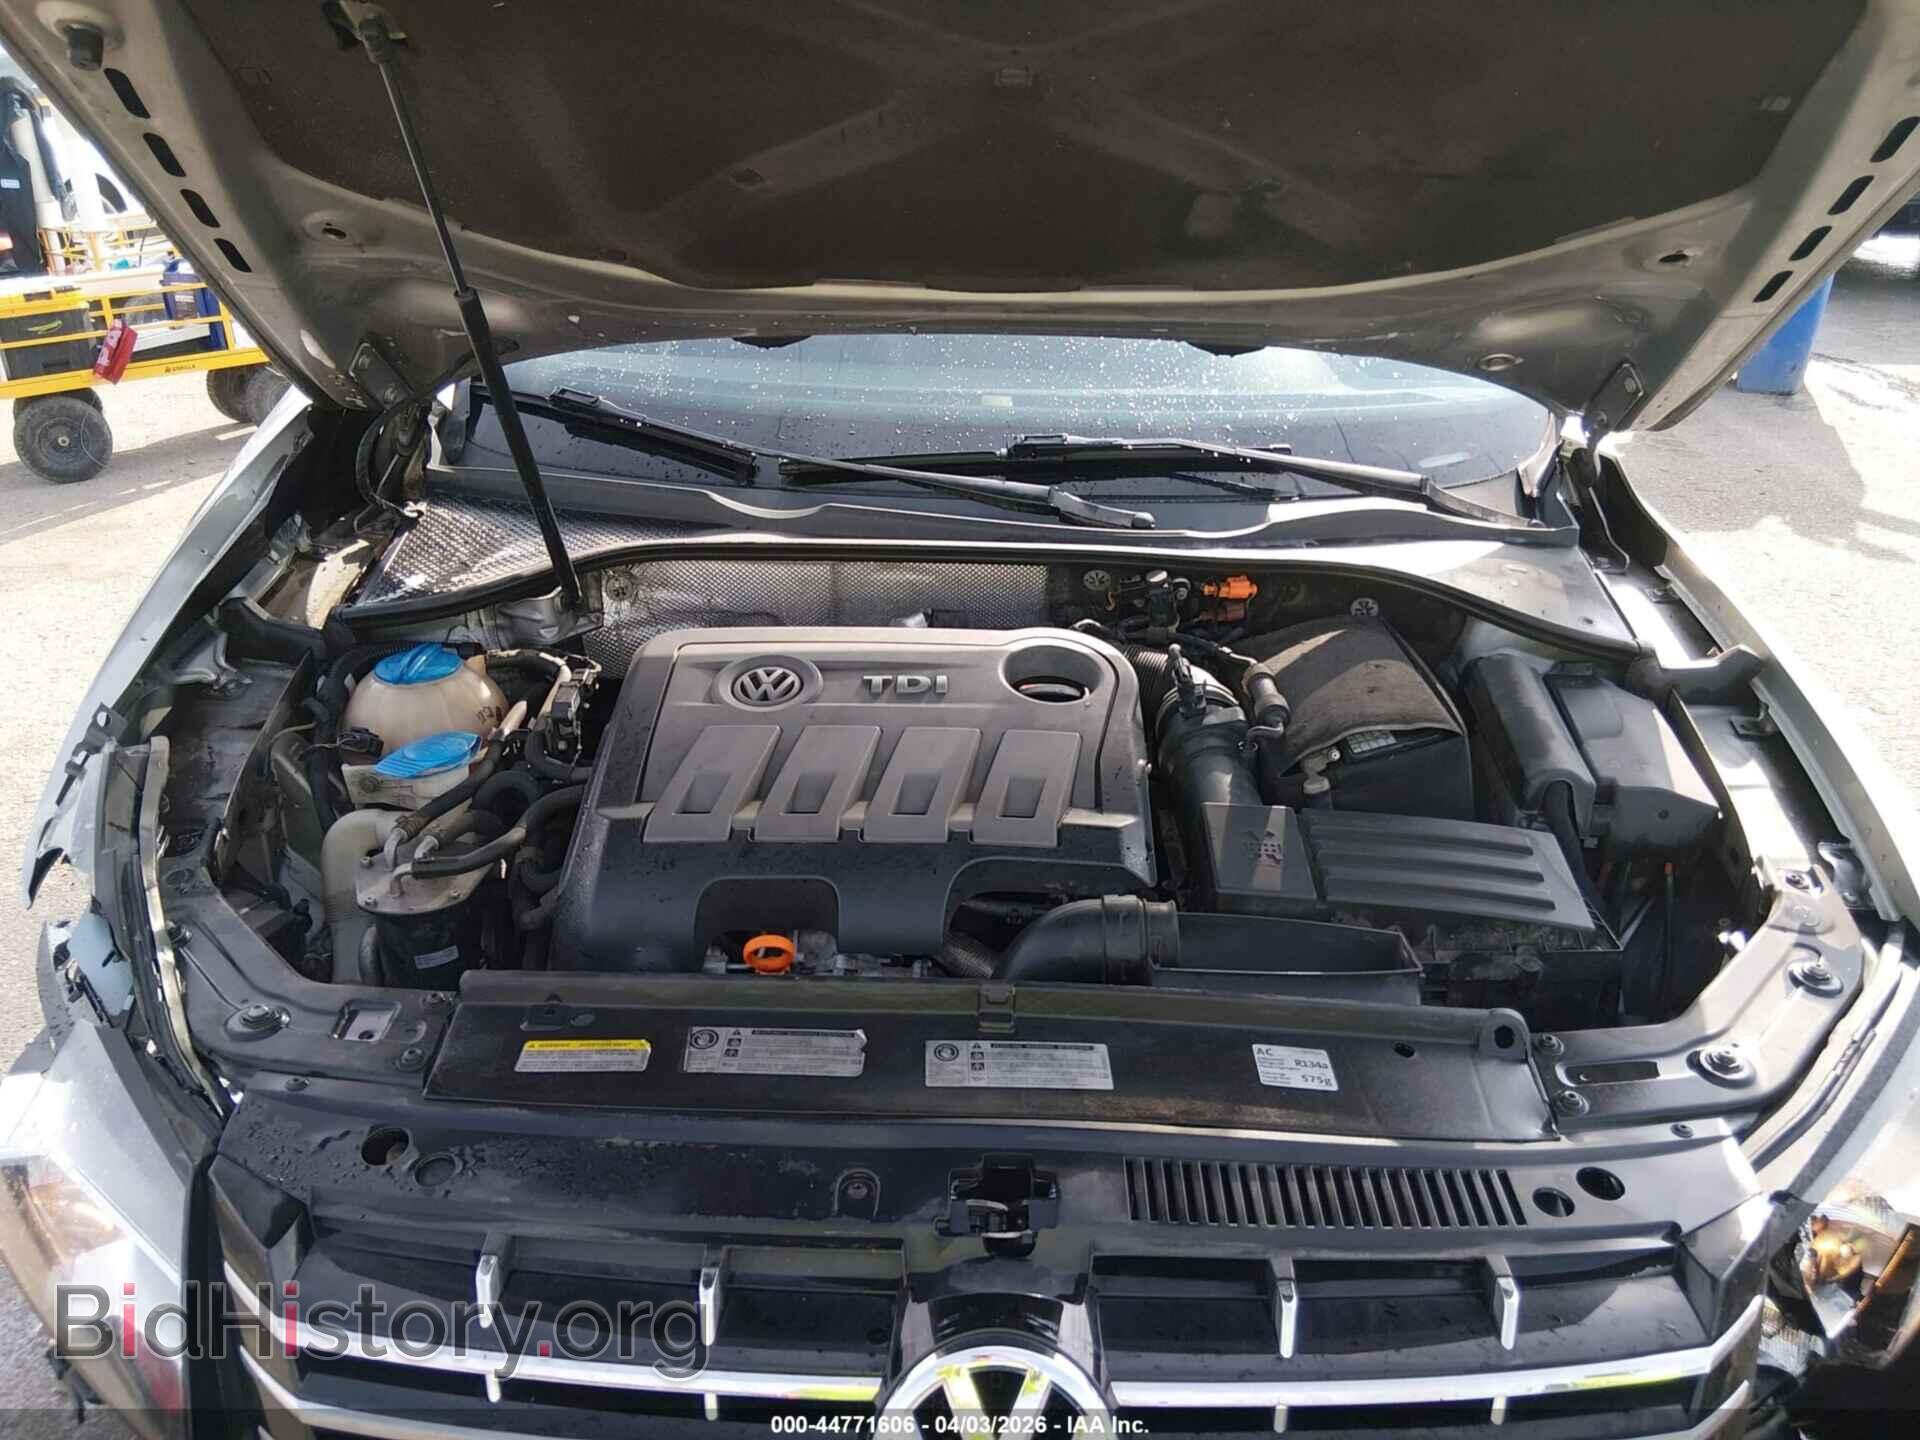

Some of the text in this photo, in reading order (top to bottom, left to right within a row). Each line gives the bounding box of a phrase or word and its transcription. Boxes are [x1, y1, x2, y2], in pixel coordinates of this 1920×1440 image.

[733, 667, 803, 706] VW
[862, 674, 949, 695] TDI
[1256, 1048, 1272, 1056] AC
